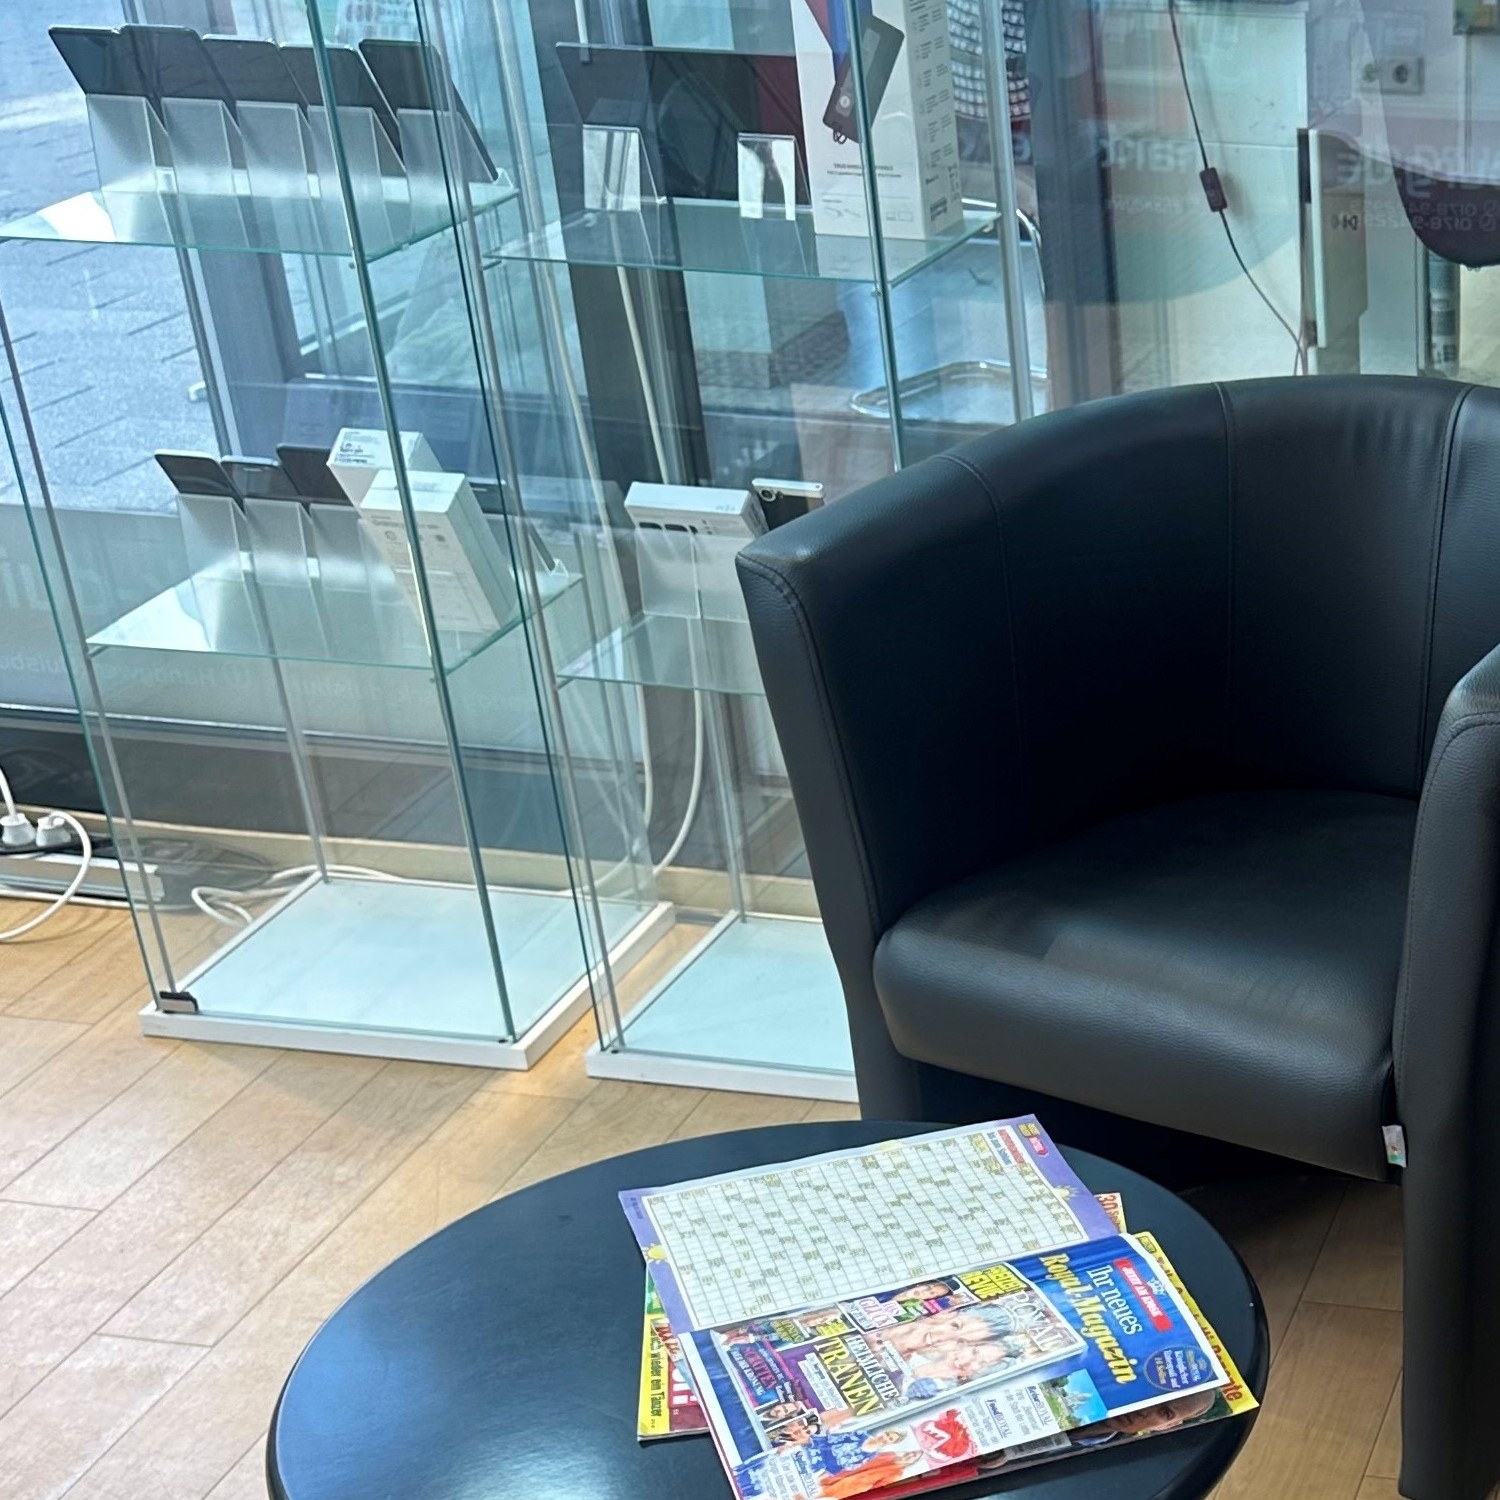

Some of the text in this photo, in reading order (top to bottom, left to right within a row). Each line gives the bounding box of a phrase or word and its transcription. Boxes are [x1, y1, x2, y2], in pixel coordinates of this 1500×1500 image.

[1012, 1289, 1075, 1351] ROYAL
[1039, 1253, 1138, 1384] Royal-Magazin
[1087, 1265, 1143, 1336] Ihr neues
[650, 1379, 664, 1390] ein
[844, 1333, 899, 1400] HEIMLICHE
